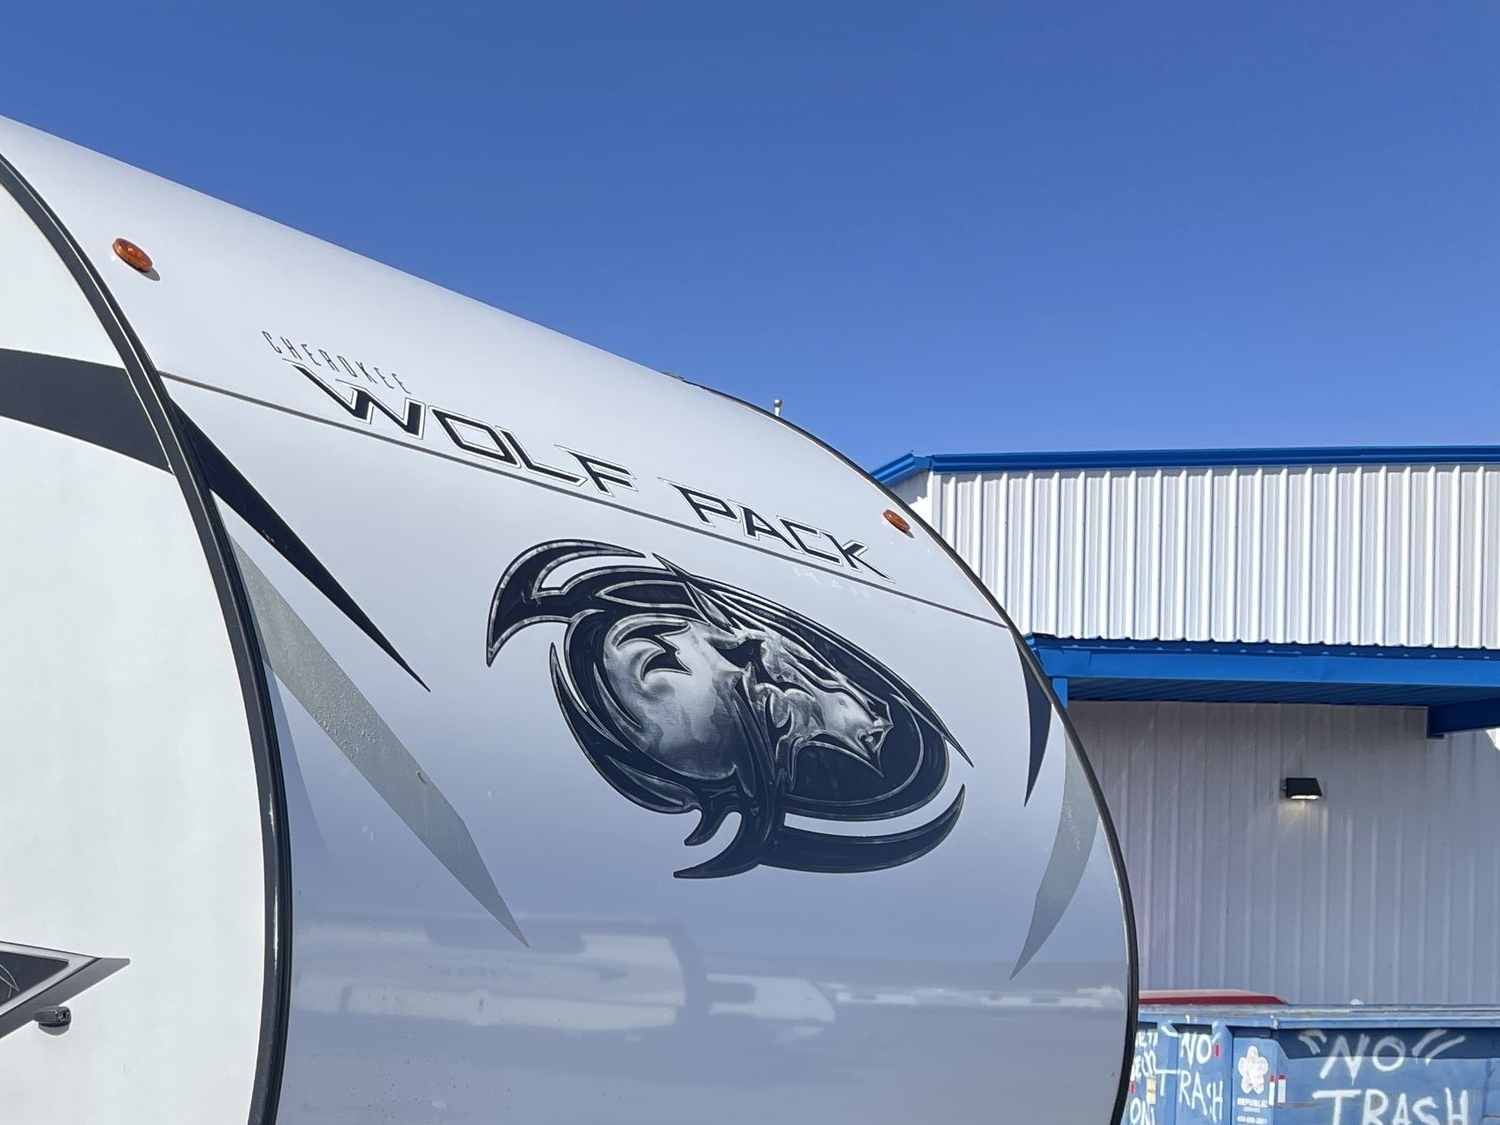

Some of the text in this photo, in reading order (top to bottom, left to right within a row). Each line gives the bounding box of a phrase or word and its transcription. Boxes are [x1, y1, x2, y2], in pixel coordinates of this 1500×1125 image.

[261, 330, 413, 396] CHEROKEE
[282, 358, 897, 584] WOLF PACK
